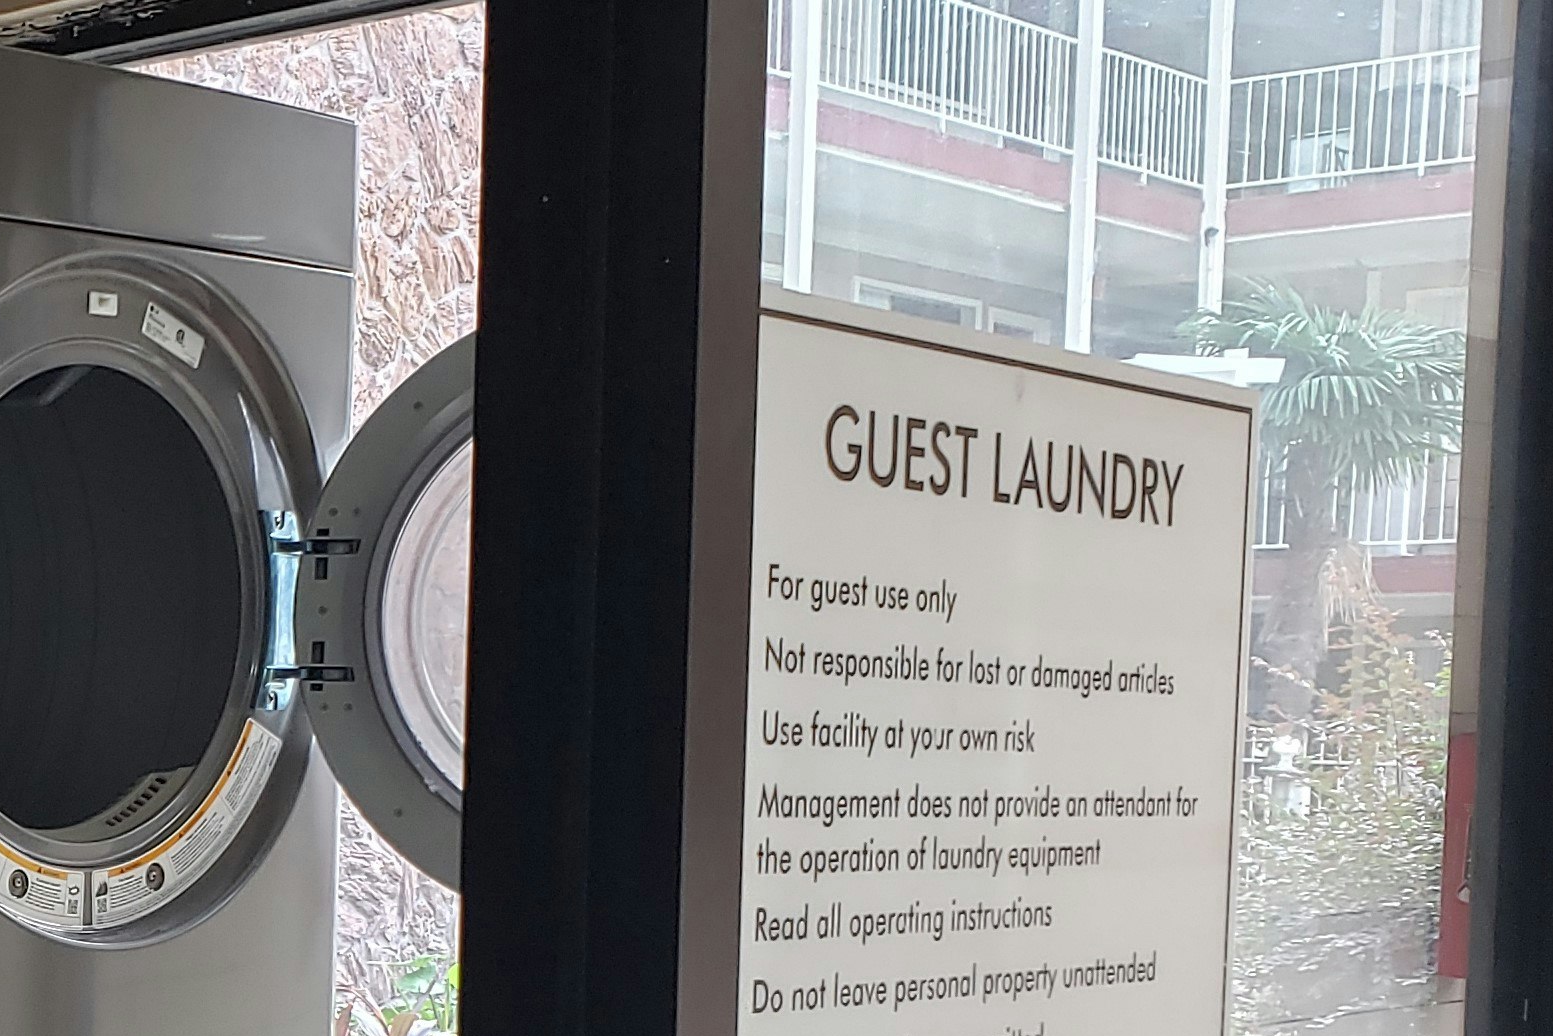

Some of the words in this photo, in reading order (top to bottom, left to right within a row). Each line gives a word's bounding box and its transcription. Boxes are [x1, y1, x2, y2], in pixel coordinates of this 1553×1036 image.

[825, 405, 977, 497] GUEST
[993, 432, 1184, 526] LAUNDRY
[767, 564, 802, 599] For
[811, 575, 867, 611] guest
[875, 582, 909, 611] use
[916, 580, 957, 623] only
[765, 638, 805, 674] Not
[813, 644, 929, 686] responsible
[936, 649, 963, 683] for
[969, 651, 1000, 686] lost
[1007, 661, 1026, 687] or
[1032, 655, 1112, 697] damaged
[1118, 663, 1174, 696] articles
[763, 711, 802, 746] Use
[810, 712, 878, 757] facility
[885, 721, 904, 748] at
[910, 727, 953, 758] your
[960, 730, 997, 751] own
[1004, 720, 1035, 753] risk
[757, 784, 900, 827] Management
[907, 783, 951, 819] does
[958, 790, 988, 818] not
[994, 784, 1059, 826] provide
[1066, 793, 1087, 817] an
[1093, 786, 1171, 817] attendant
[1176, 786, 1198, 816] for
[756, 838, 791, 875] the
[800, 839, 899, 882] operation
[907, 837, 927, 871] of
[932, 836, 1002, 877] laundry
[1008, 836, 1100, 875] equipment
[754, 904, 808, 941] Read
[817, 903, 841, 939] all
[849, 901, 944, 944] operating
[950, 898, 1052, 932] instructions
[752, 979, 783, 1013] Do
[791, 979, 826, 1010] not
[833, 973, 887, 1008] leave
[894, 964, 976, 1011] personal
[983, 963, 1057, 1003] property
[1063, 950, 1155, 989] unattended
